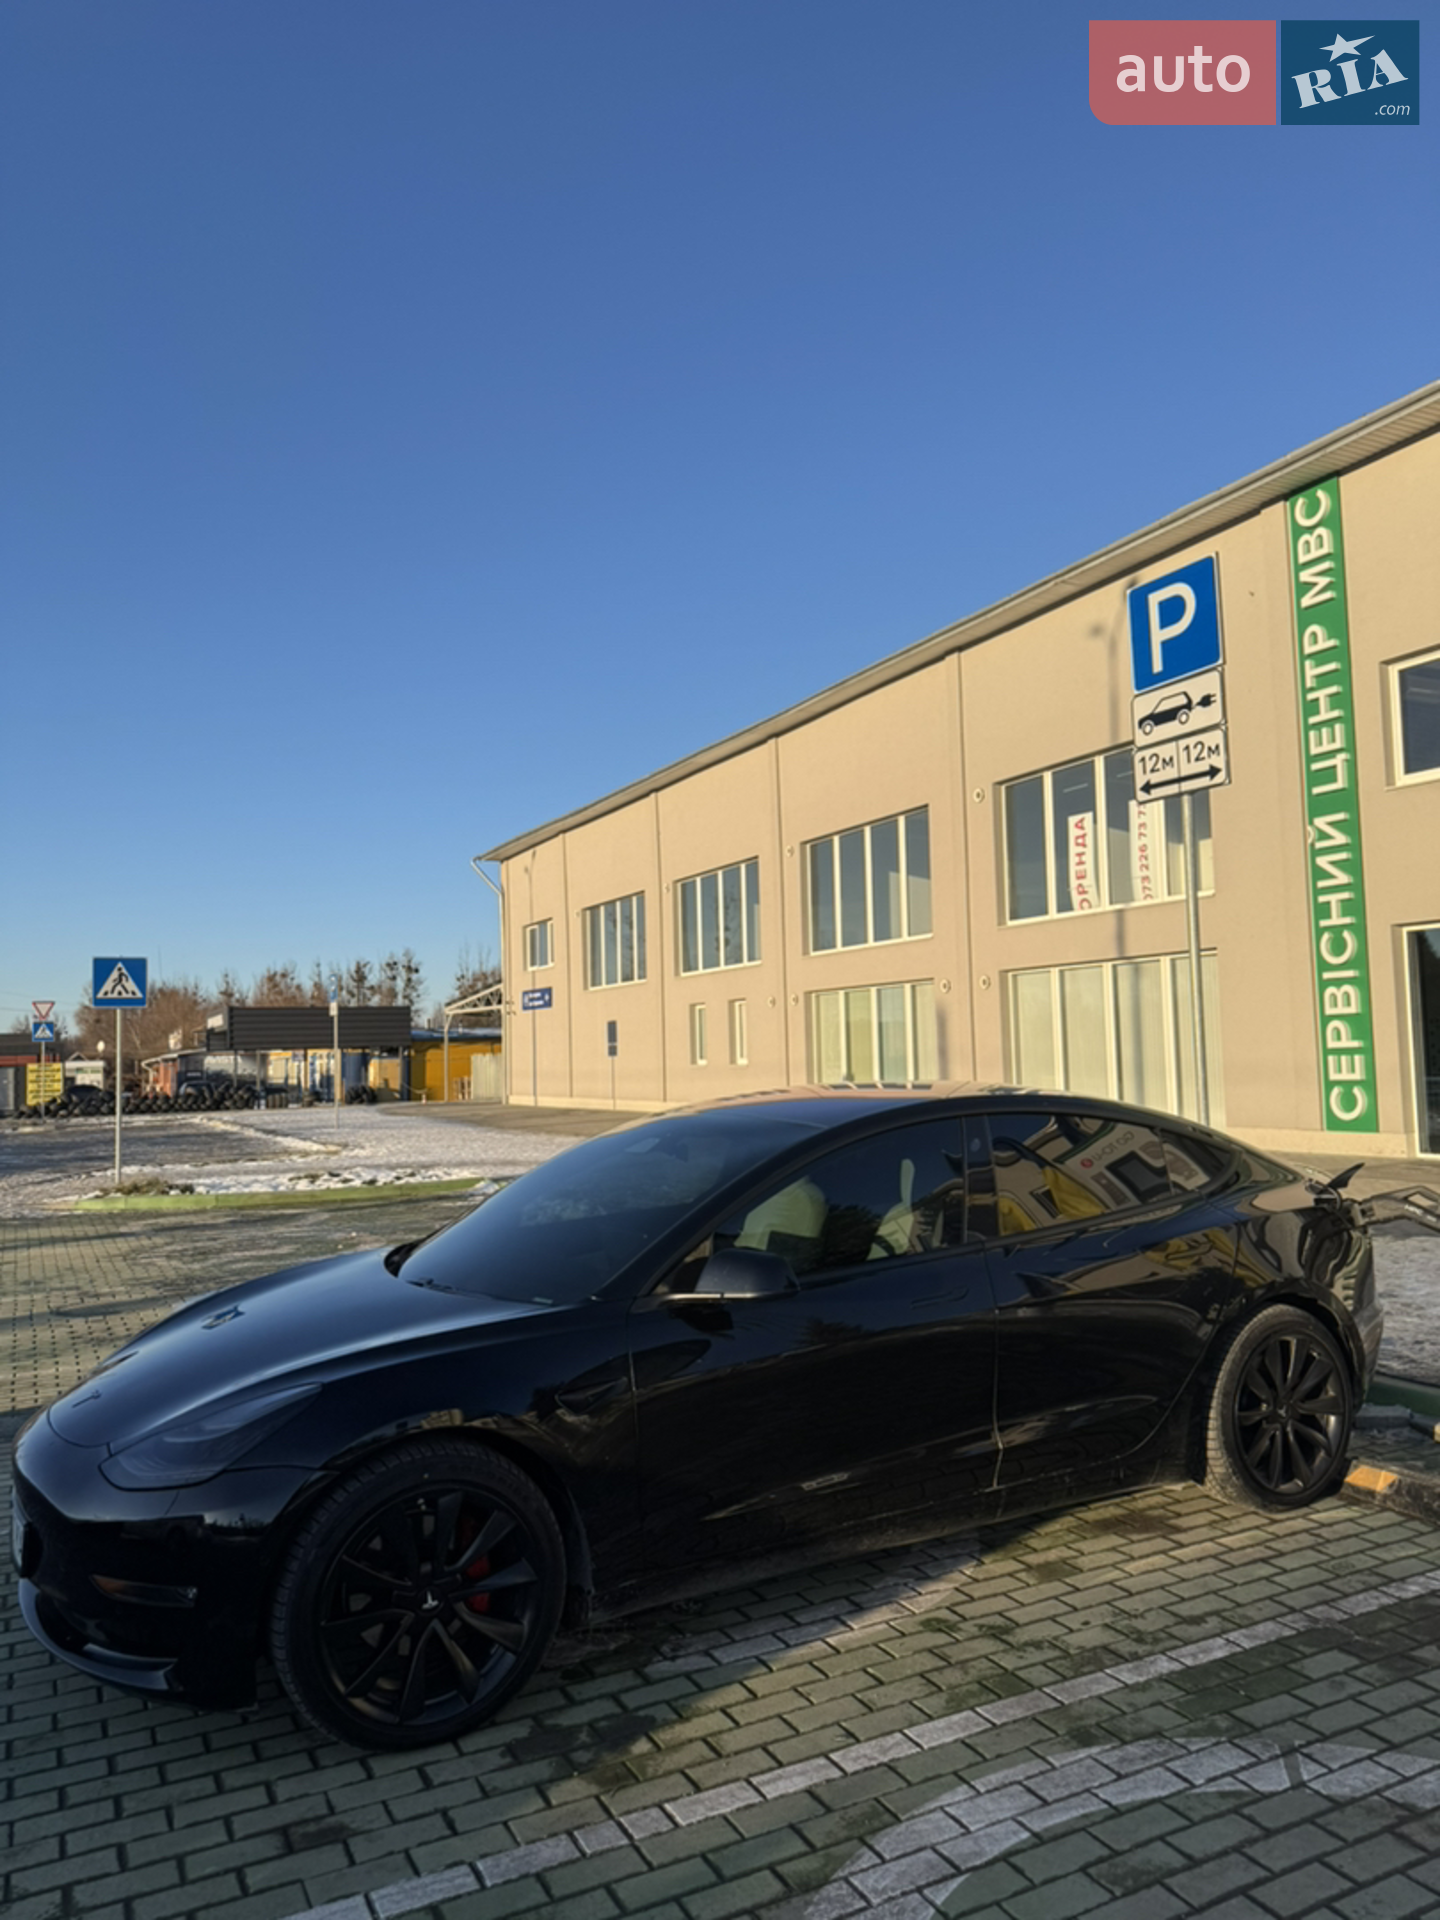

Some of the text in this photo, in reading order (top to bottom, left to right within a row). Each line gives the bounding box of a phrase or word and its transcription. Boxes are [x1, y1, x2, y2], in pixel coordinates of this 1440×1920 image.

[1148, 582, 1197, 674] P
[1294, 489, 1368, 1121] СЕРВІСНИЙ ЦЕНТР МВС
[1074, 817, 1092, 911] ОРЕНДА
[1138, 844, 1150, 872] 226
